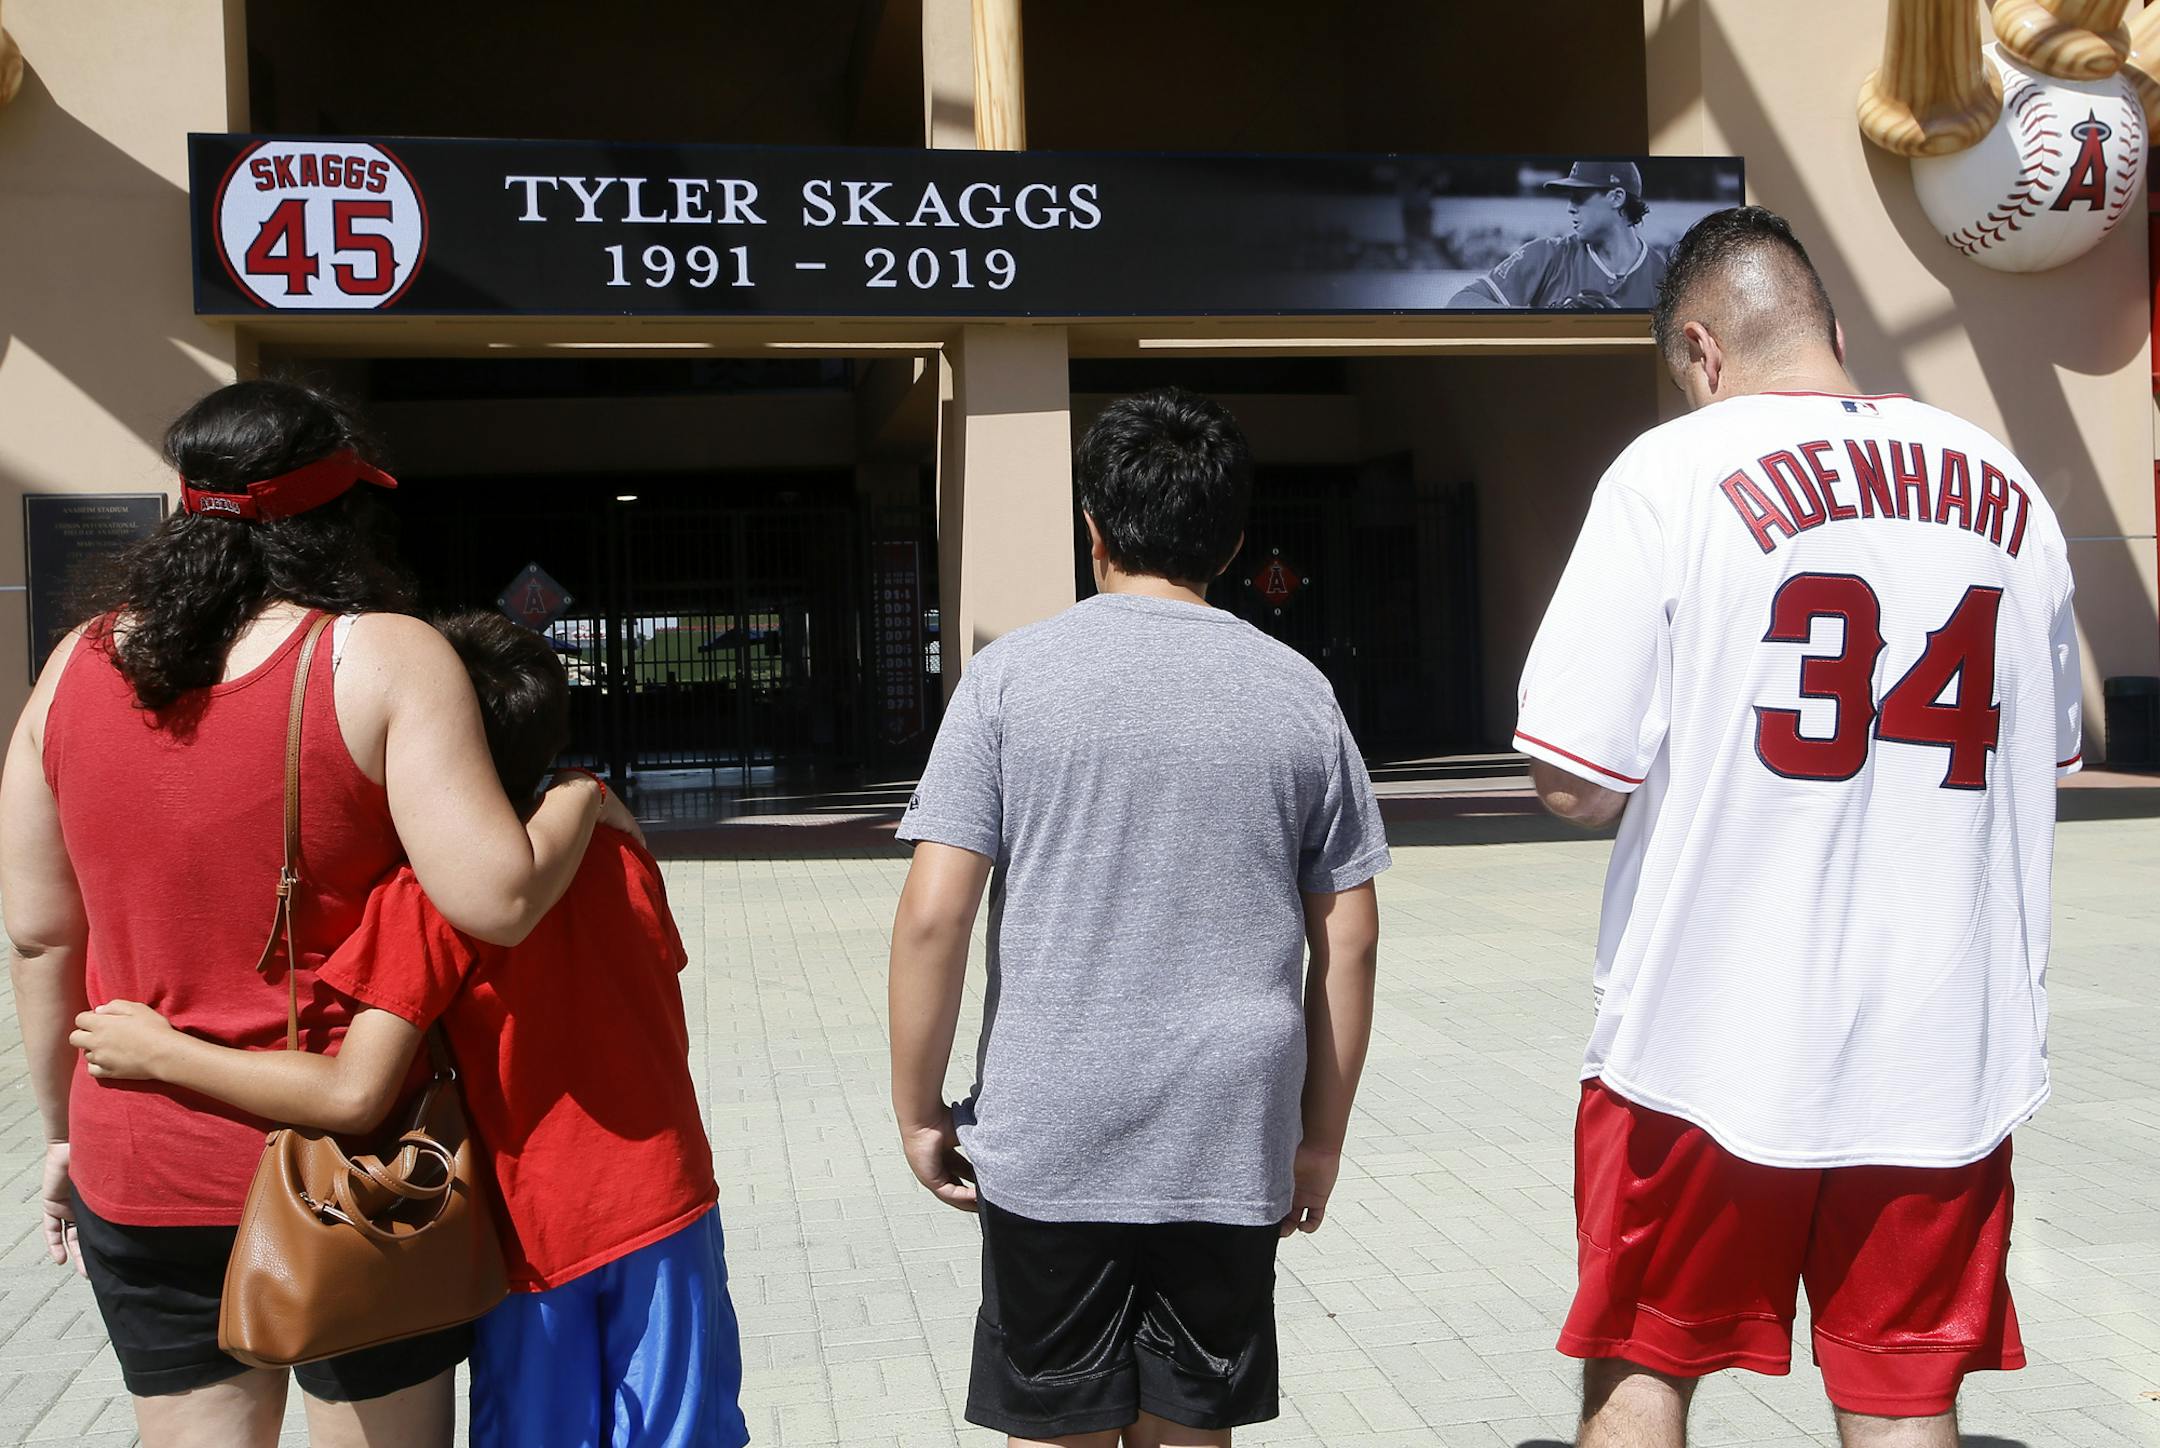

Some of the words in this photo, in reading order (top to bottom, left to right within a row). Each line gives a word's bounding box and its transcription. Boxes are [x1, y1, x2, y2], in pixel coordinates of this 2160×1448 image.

[250, 153, 390, 194] SKAGGS
[504, 175, 768, 224] TYLER
[802, 179, 1102, 230] SKAGGS
[244, 198, 402, 296] 45
[604, 244, 755, 288] 1991
[864, 247, 1017, 290] 2019
[1719, 439, 2033, 559] ADENHART
[1752, 571, 2004, 791] 34
